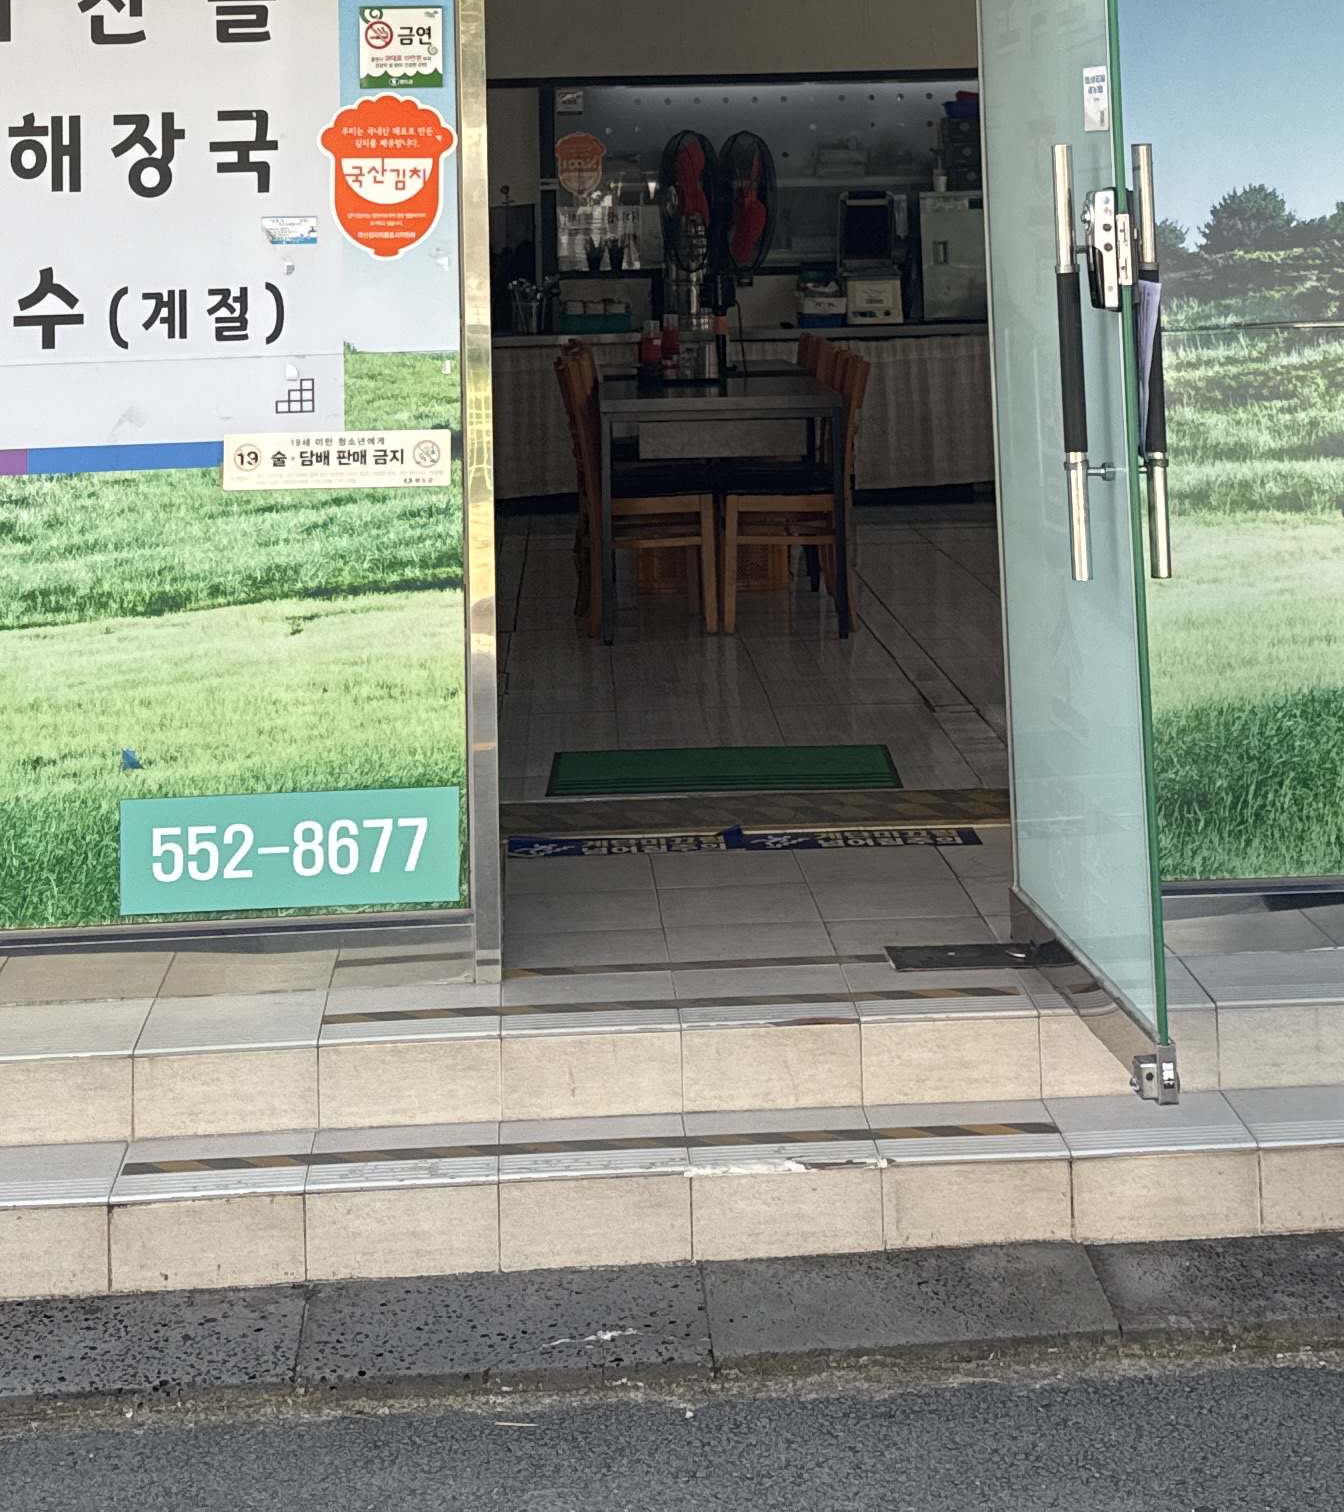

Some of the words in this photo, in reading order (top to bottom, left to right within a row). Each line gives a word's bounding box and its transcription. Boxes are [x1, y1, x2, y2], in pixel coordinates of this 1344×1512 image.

[397, 25, 432, 46] 금연
[344, 158, 427, 191] 국산김치
[237, 451, 259, 466] 19
[336, 449, 368, 466] 판매
[372, 448, 405, 465] 금지
[152, 817, 428, 882] 552-8677
